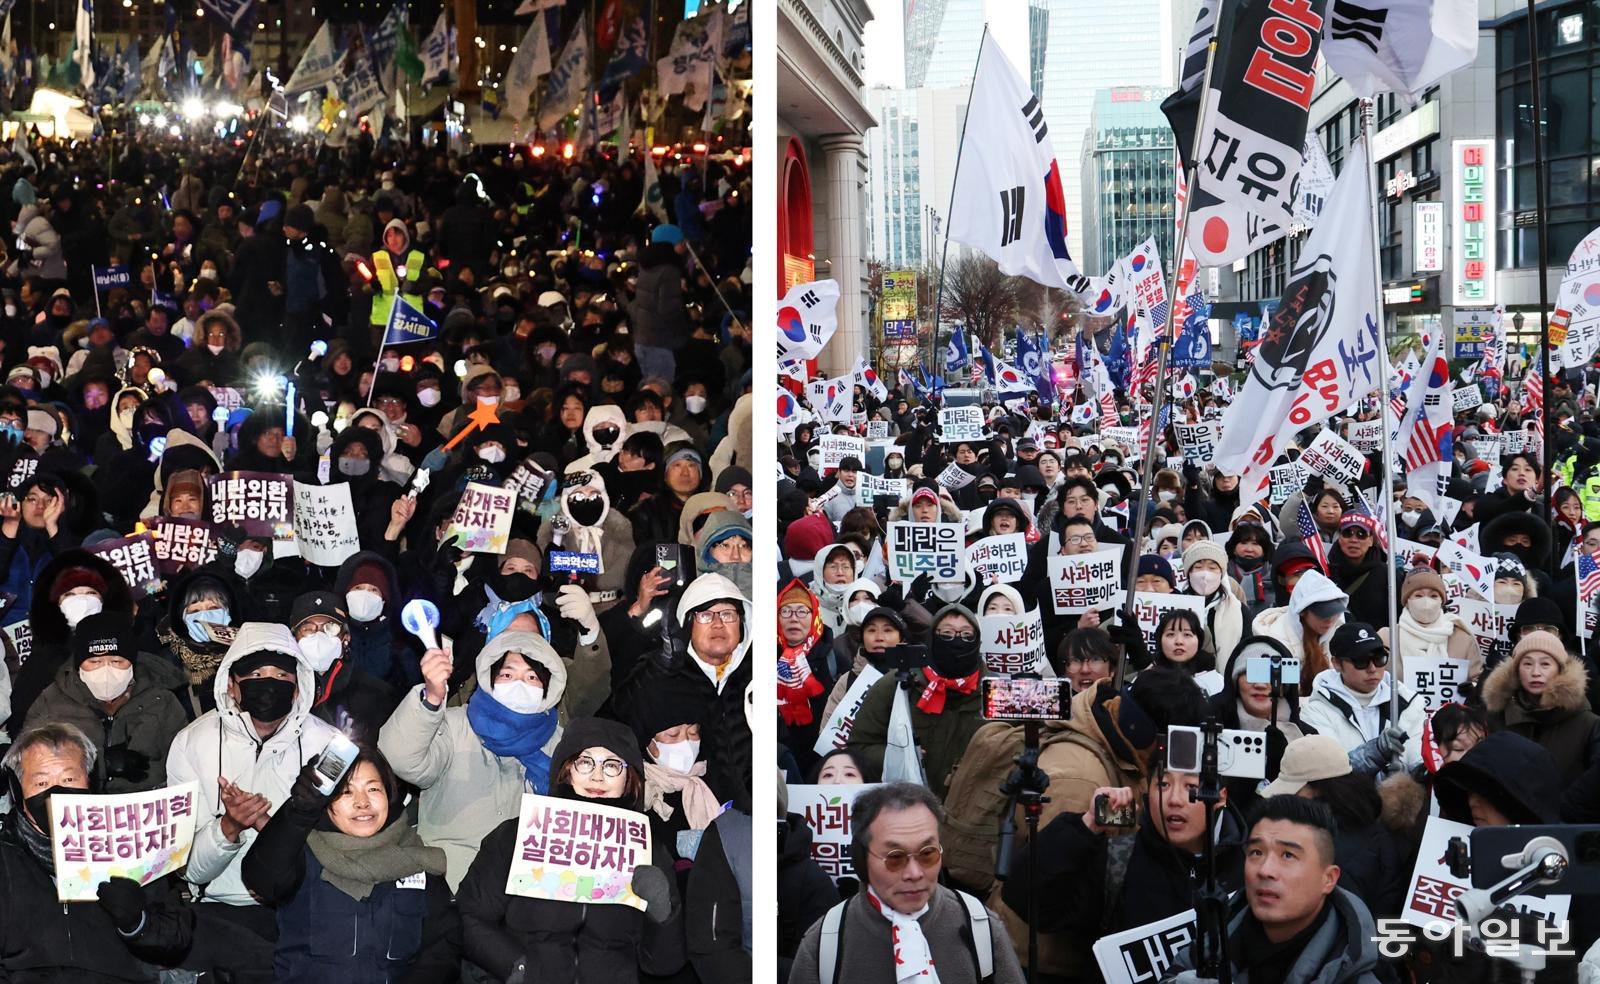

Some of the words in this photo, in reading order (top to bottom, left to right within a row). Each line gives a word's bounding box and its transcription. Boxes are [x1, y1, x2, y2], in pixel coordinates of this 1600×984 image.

[944, 410, 980, 425] 내란은
[944, 424, 981, 440] 민주당
[1320, 440, 1361, 476] 사과하면
[211, 478, 288, 502] 내란외환
[211, 500, 288, 524] 청산하자
[156, 523, 218, 549] 내란외
[895, 526, 958, 553] 내란은
[553, 556, 598, 568] 조국혁신당
[970, 542, 1017, 564] 사과하면
[896, 554, 959, 579] 민주당
[1060, 560, 1115, 585] 사과하면
[1055, 581, 1120, 608] 죽음뿐이다
[88, 643, 118, 653] amazon
[59, 791, 193, 833] 사회대개혁
[526, 806, 648, 849] 사회대개혁
[61, 823, 178, 863] 실현하자!
[521, 833, 636, 874] 실현하자!
